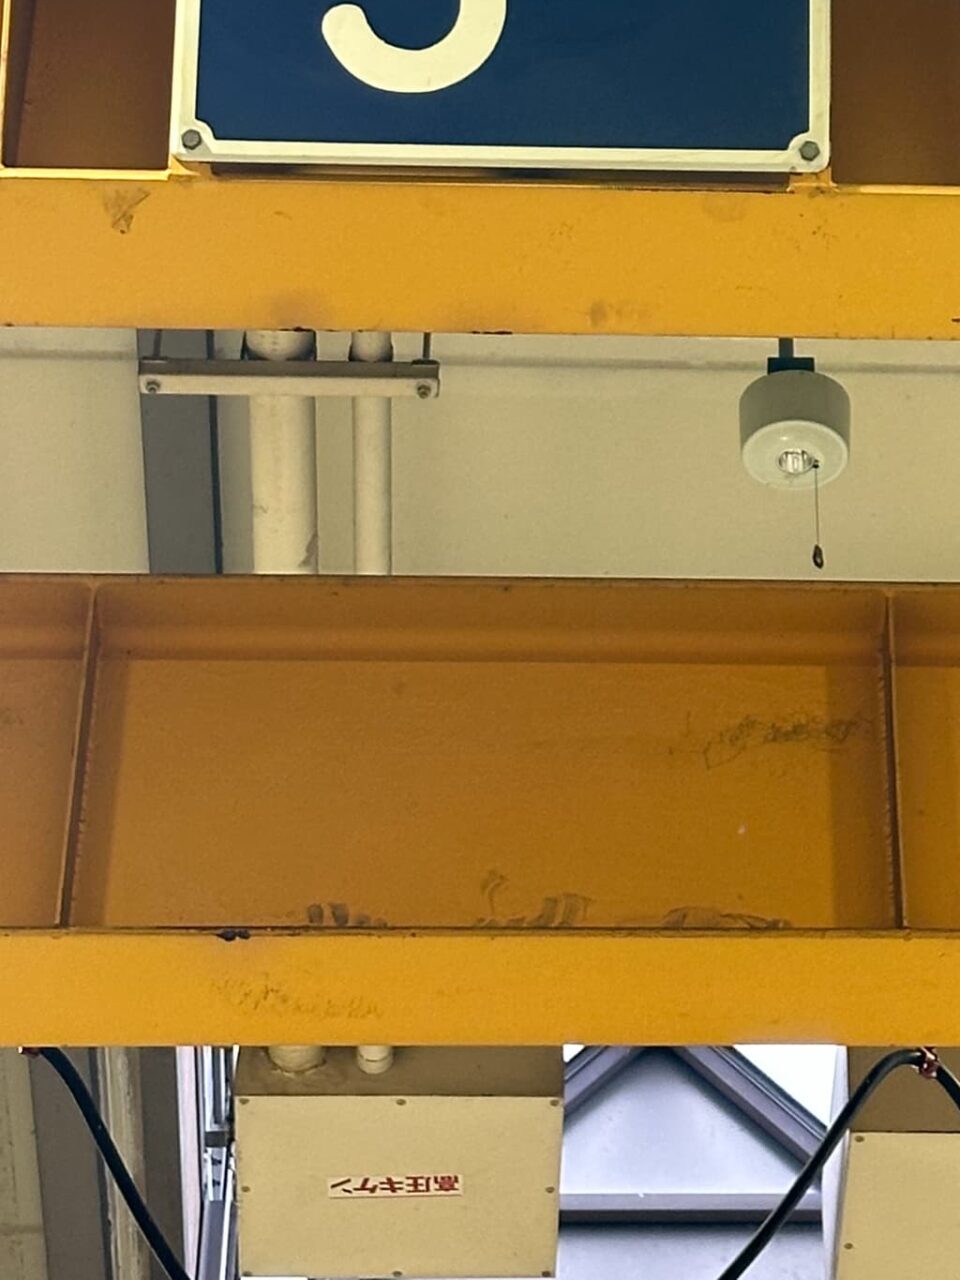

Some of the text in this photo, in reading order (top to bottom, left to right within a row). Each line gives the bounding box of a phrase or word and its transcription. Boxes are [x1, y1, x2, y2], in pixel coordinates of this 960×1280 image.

[330, 1175, 460, 1194] 高圧キケン
